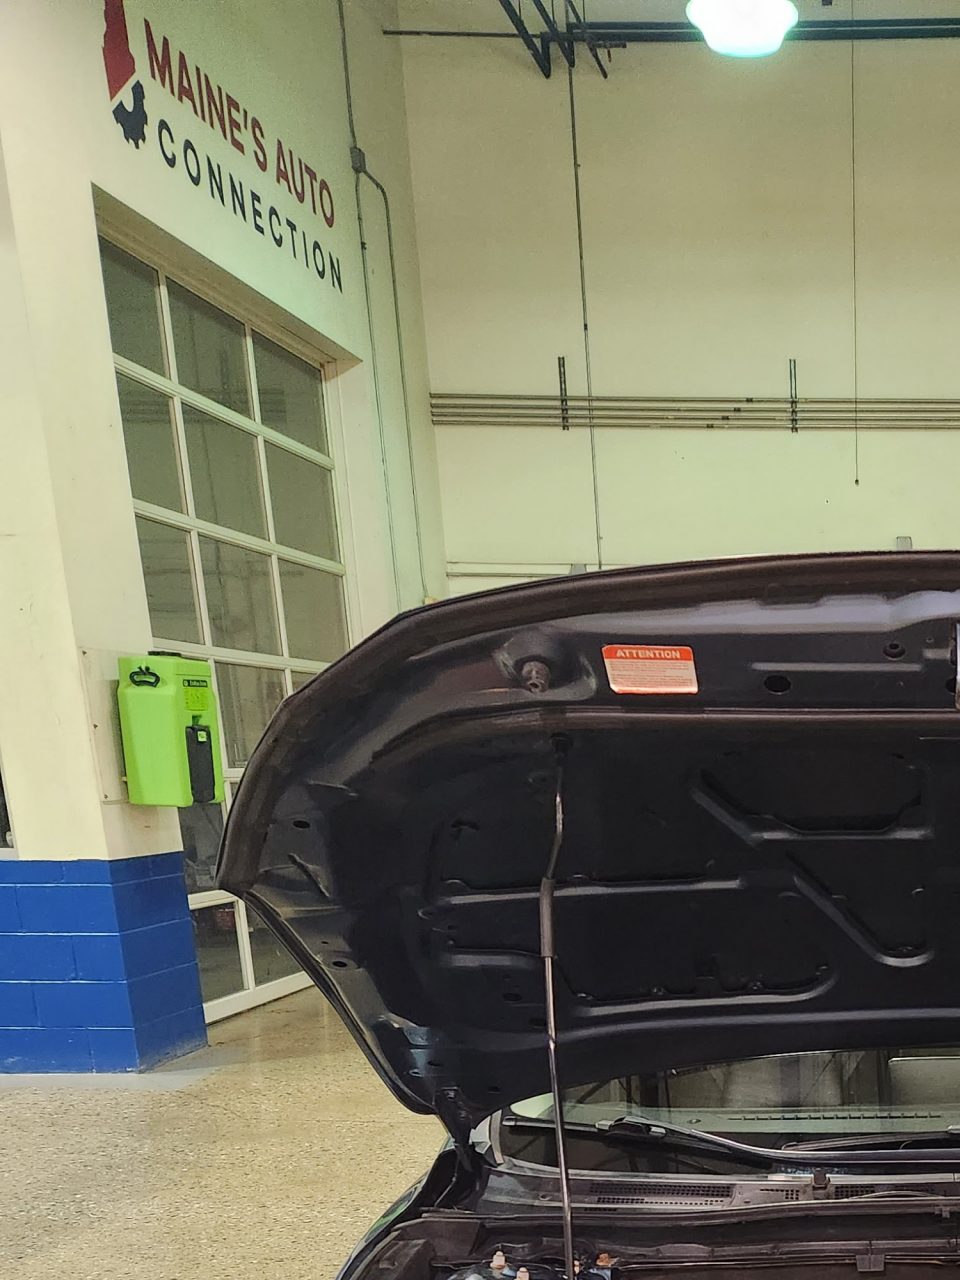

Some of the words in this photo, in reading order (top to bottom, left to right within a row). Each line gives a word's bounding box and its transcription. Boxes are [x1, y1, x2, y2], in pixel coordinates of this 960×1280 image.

[144, 17, 268, 173] MAINE'S
[275, 138, 335, 229] AUTO
[157, 118, 343, 293] CONNECTION
[616, 649, 680, 658] ATTENTION
